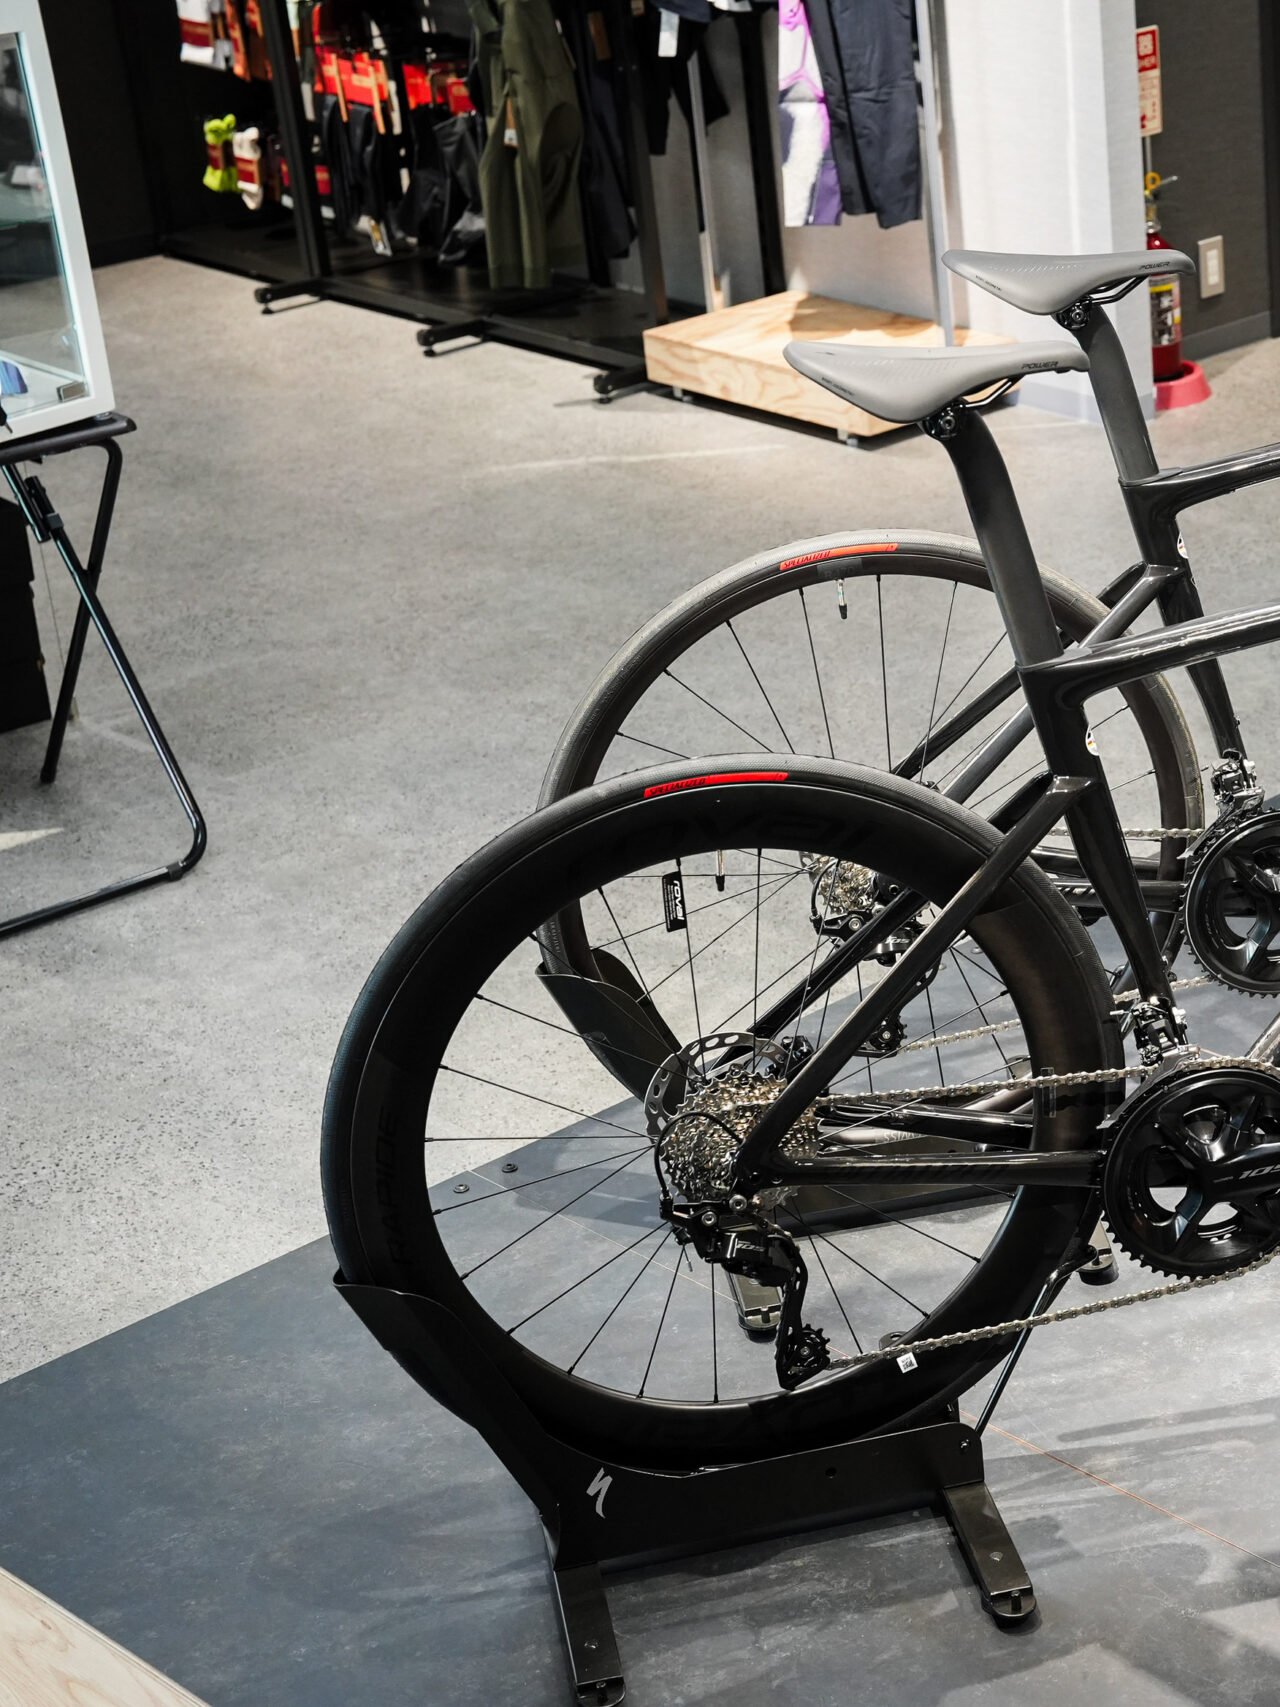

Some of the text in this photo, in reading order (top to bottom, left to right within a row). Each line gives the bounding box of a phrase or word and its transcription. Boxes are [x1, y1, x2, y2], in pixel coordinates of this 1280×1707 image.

[1139, 261, 1170, 271] POWER
[1021, 361, 1060, 371] POWER
[673, 880, 685, 920] roval
[376, 1105, 414, 1264] RAPIDE
